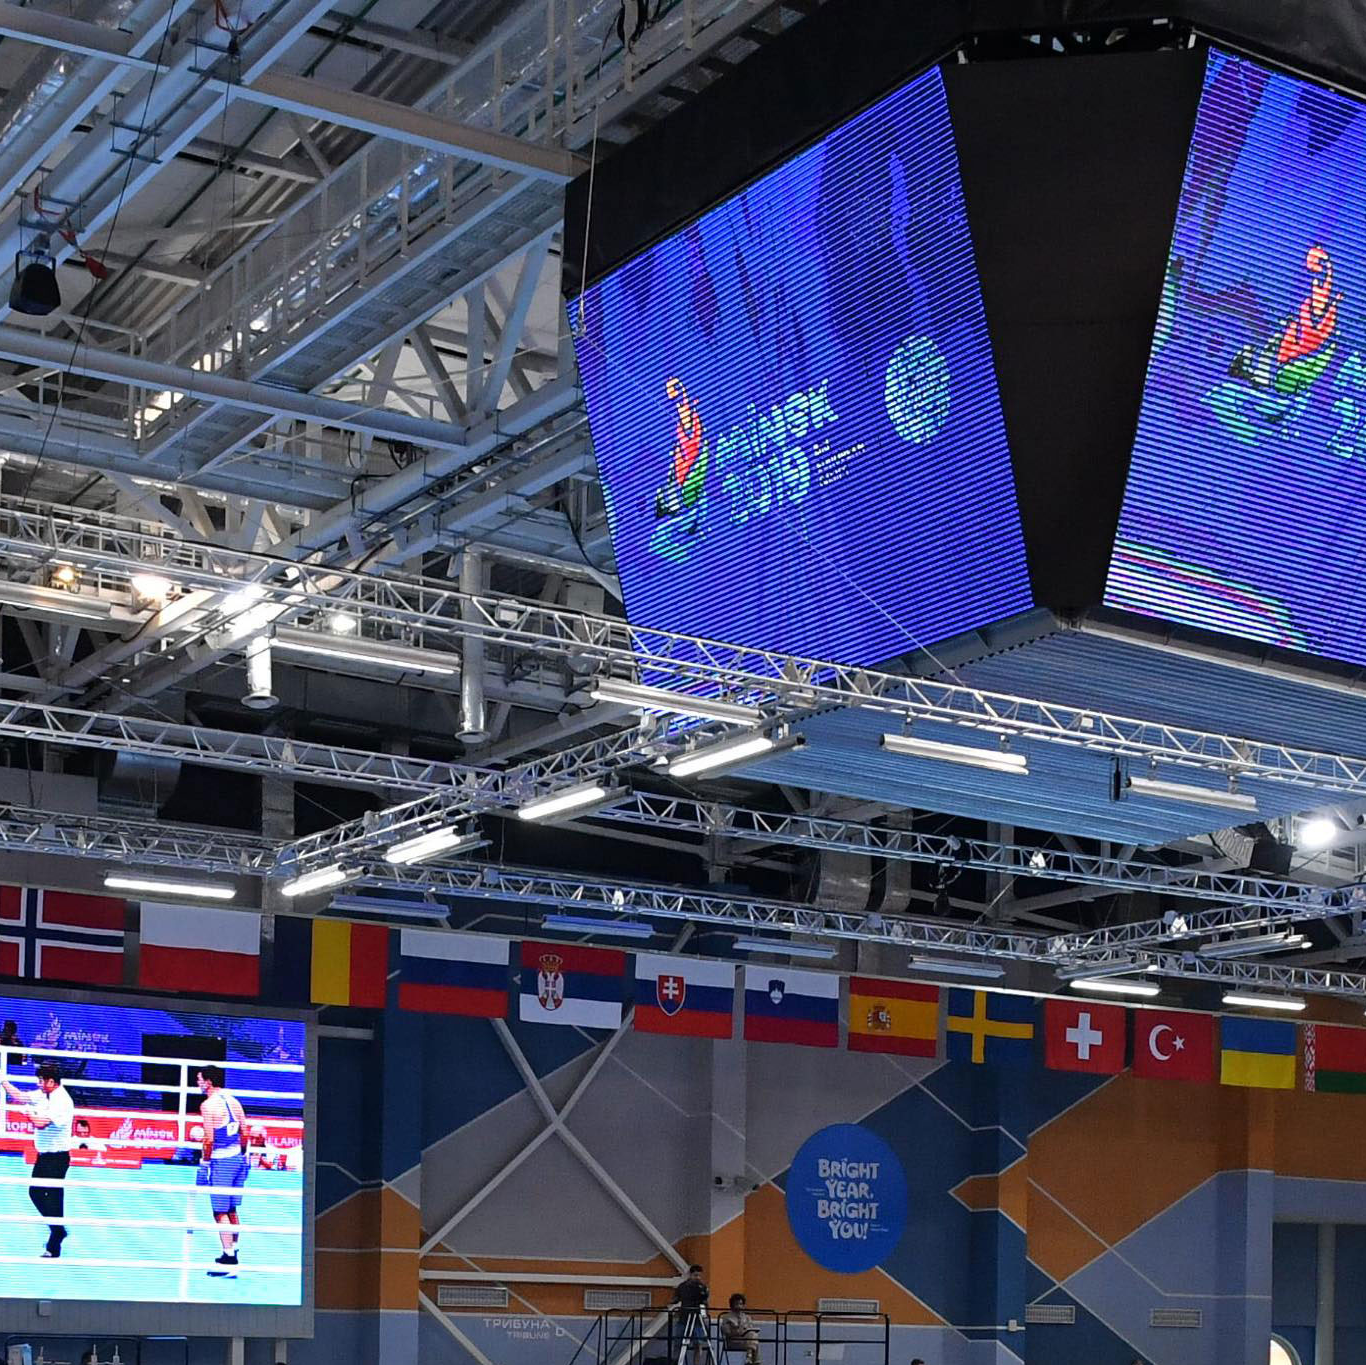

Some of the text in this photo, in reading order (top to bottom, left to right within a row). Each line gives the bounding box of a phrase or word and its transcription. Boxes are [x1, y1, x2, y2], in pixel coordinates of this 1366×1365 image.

[818, 1158, 880, 1180] BRIGHT
[817, 1198, 879, 1219] BRIGHT
[829, 1217, 868, 1239] YOU!
